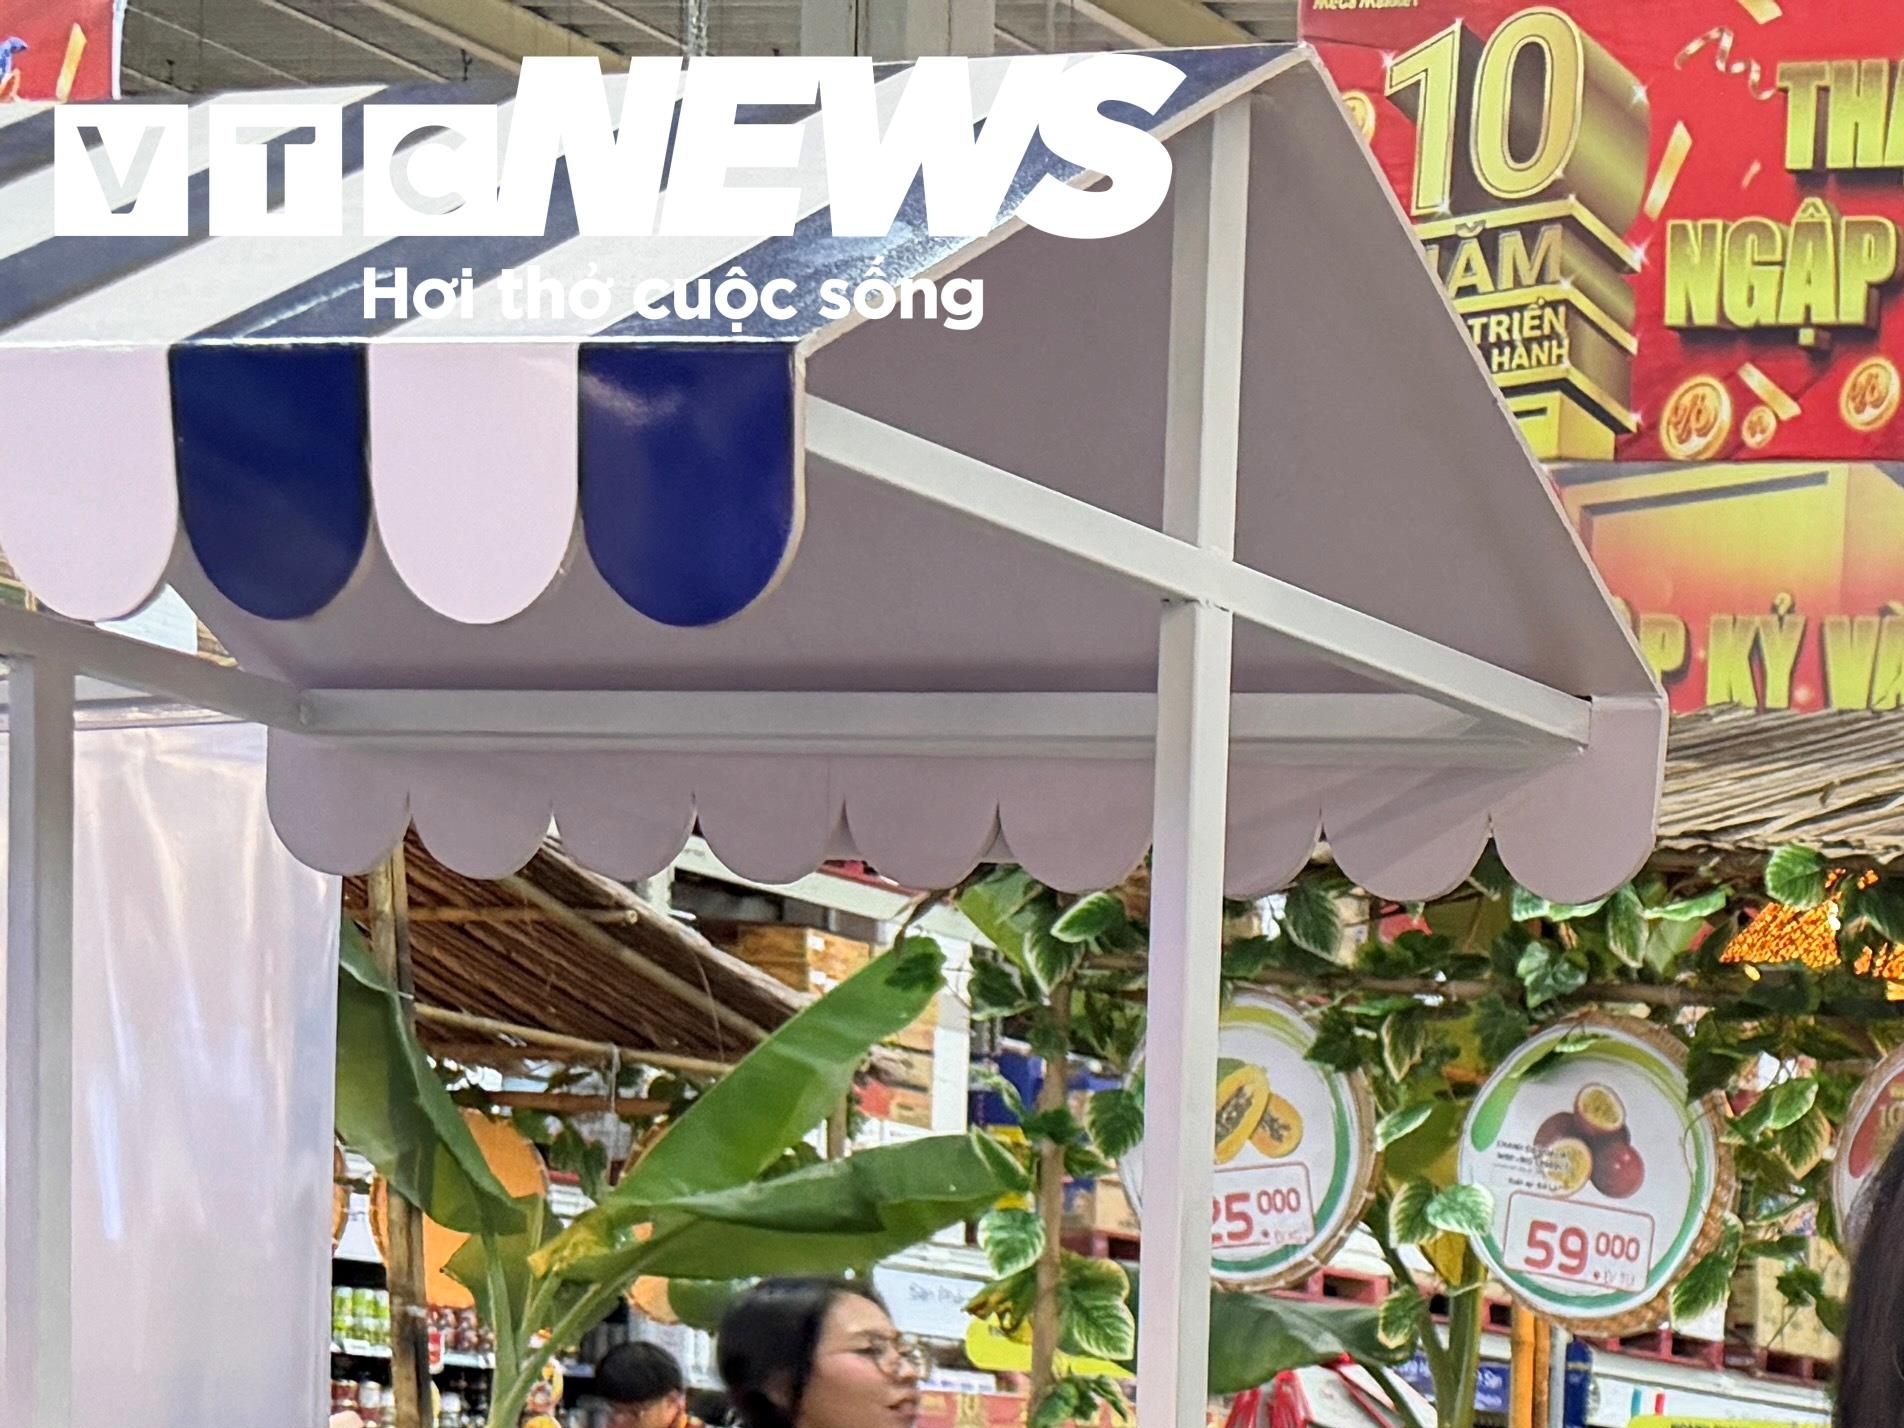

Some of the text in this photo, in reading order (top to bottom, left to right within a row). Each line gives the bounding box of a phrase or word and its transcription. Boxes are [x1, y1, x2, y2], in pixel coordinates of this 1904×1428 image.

[1386, 7, 1590, 217] 10
[1425, 220, 1563, 297] ĂM
[1665, 198, 1904, 349] NGẬP
[1467, 297, 1567, 344] TRIỂN
[1492, 338, 1570, 372] HÀNH
[1707, 592, 1806, 709] KỶ
[1257, 1187, 1300, 1215] 000
[1524, 1220, 1640, 1276] 59 000
